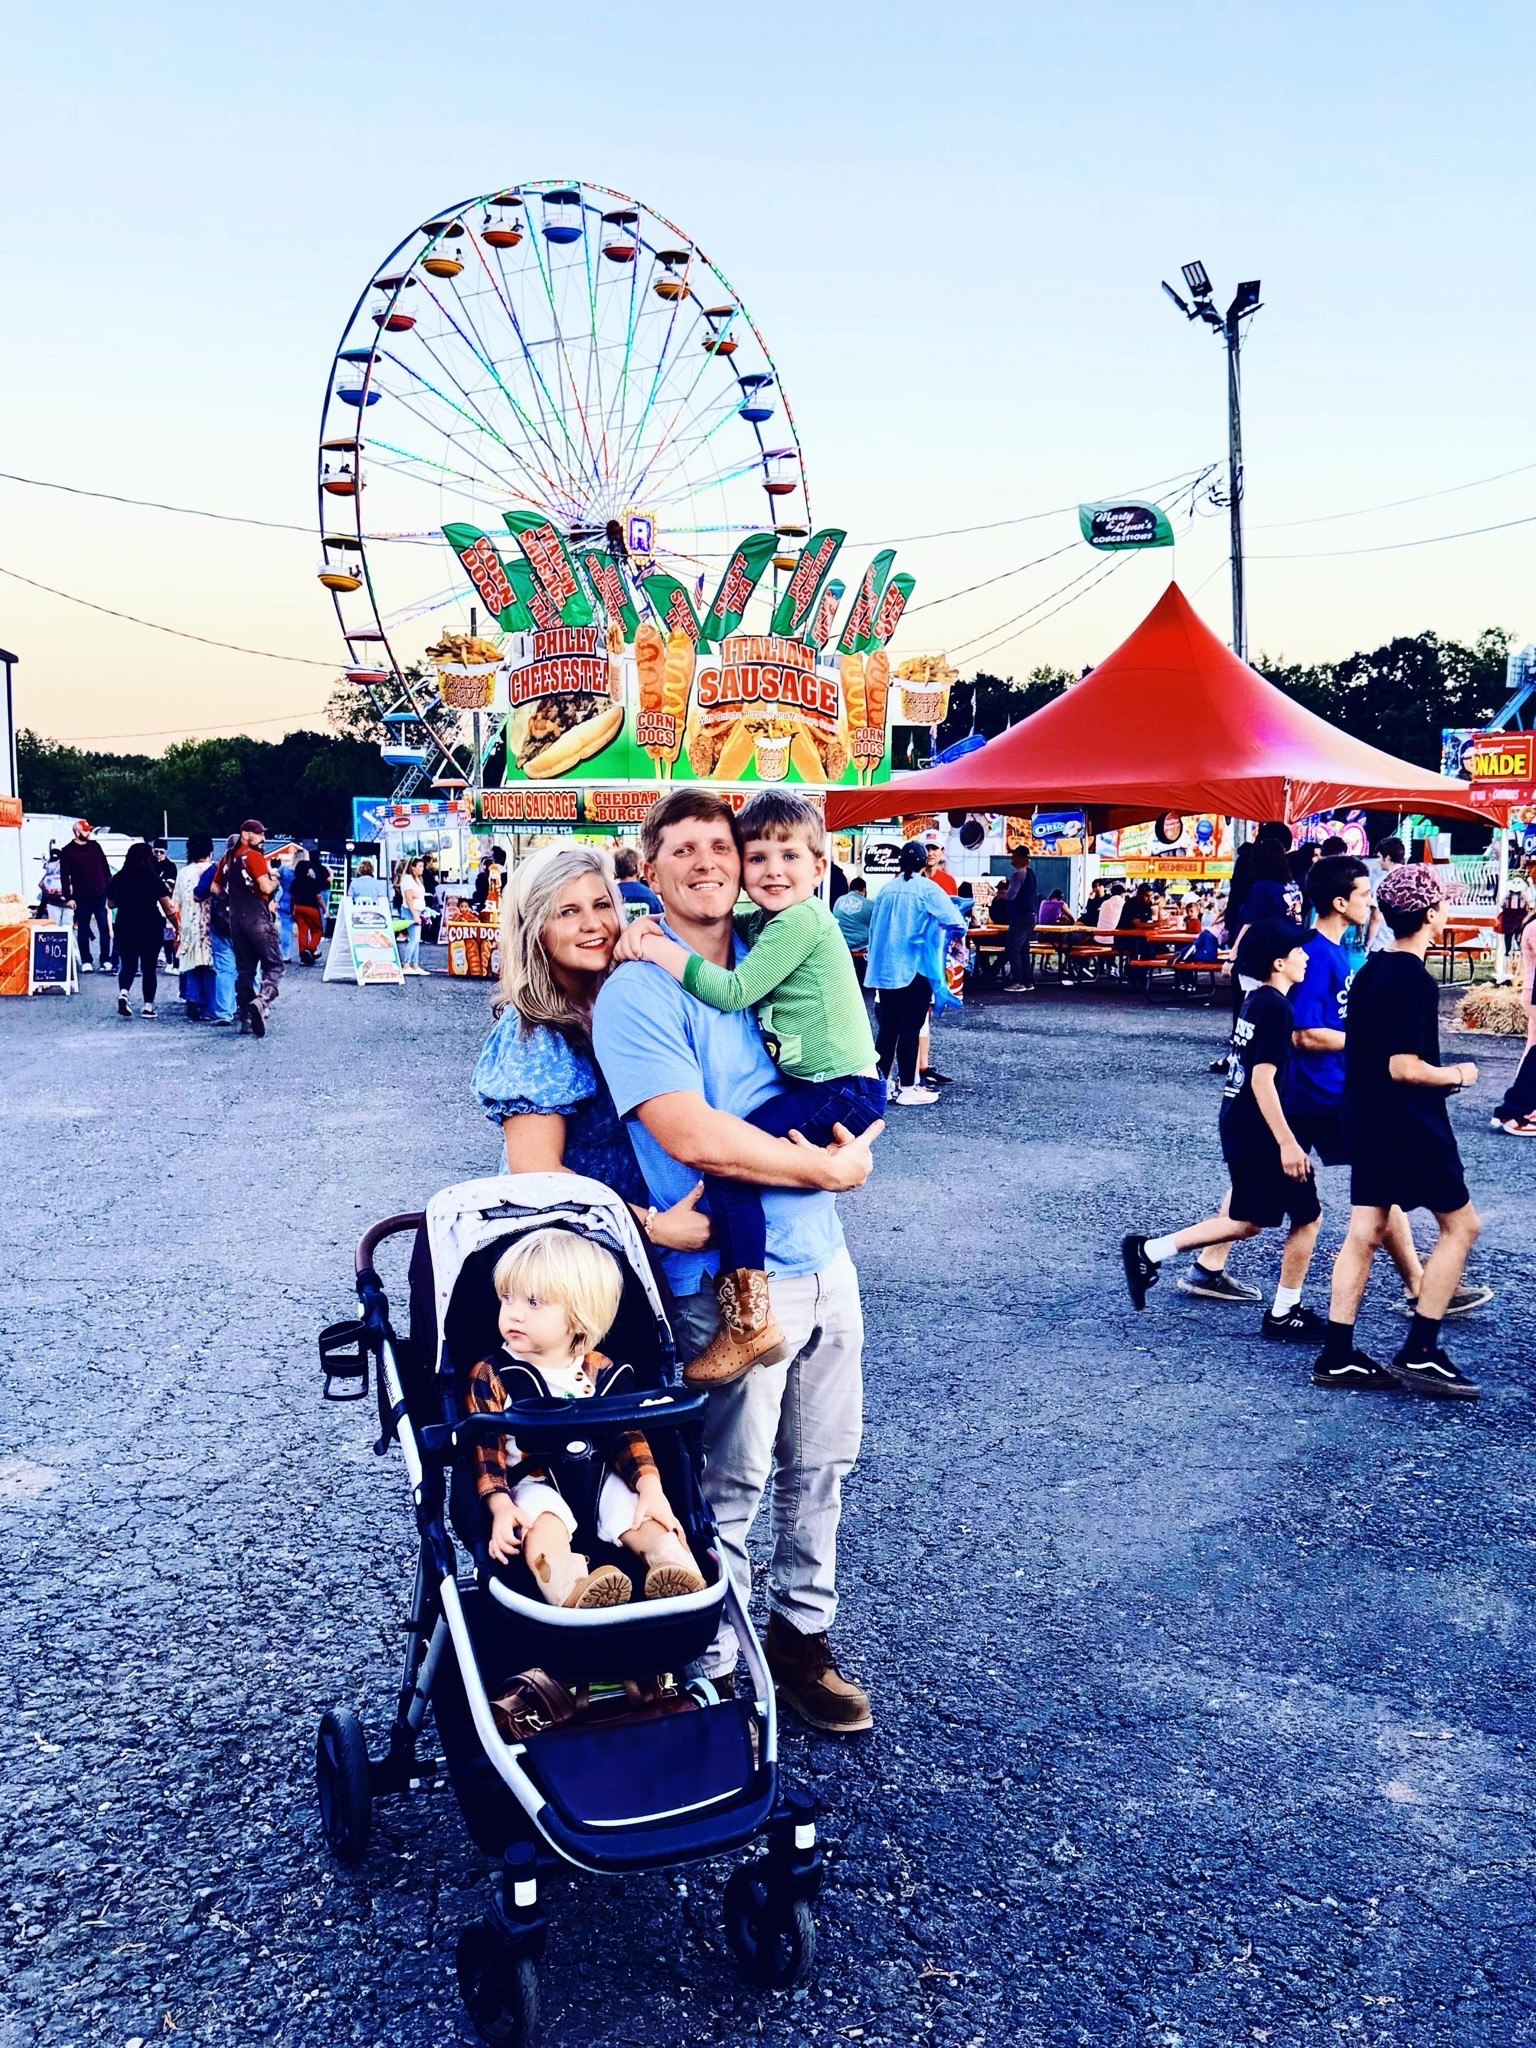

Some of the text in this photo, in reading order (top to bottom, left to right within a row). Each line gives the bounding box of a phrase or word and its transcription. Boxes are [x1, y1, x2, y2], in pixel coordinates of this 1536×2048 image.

[1095, 512, 1134, 523] Marty
[1112, 519, 1152, 536] Lynn's
[475, 537, 517, 607] CORN
[460, 547, 502, 615] DOGS
[714, 553, 748, 618] SWEET
[727, 577, 753, 614] TEA
[534, 627, 597, 658] PHILLY
[723, 637, 815, 672] ITALIAN
[510, 658, 609, 706] CHEESESTEA
[699, 664, 838, 716] SAUSAGE
[637, 712, 675, 730] CORN
[637, 729, 675, 746] DOGS
[854, 727, 884, 743] CORN
[854, 742, 884, 757] DOGS
[481, 791, 577, 820] POLISH SAUSAGE
[593, 791, 659, 806] CHEDDAR
[598, 807, 647, 821] BURGE
[492, 825, 513, 834] FRESH
[865, 845, 892, 857] Marty
[878, 856, 901, 867] Lynn'
[449, 927, 477, 941] CORN
